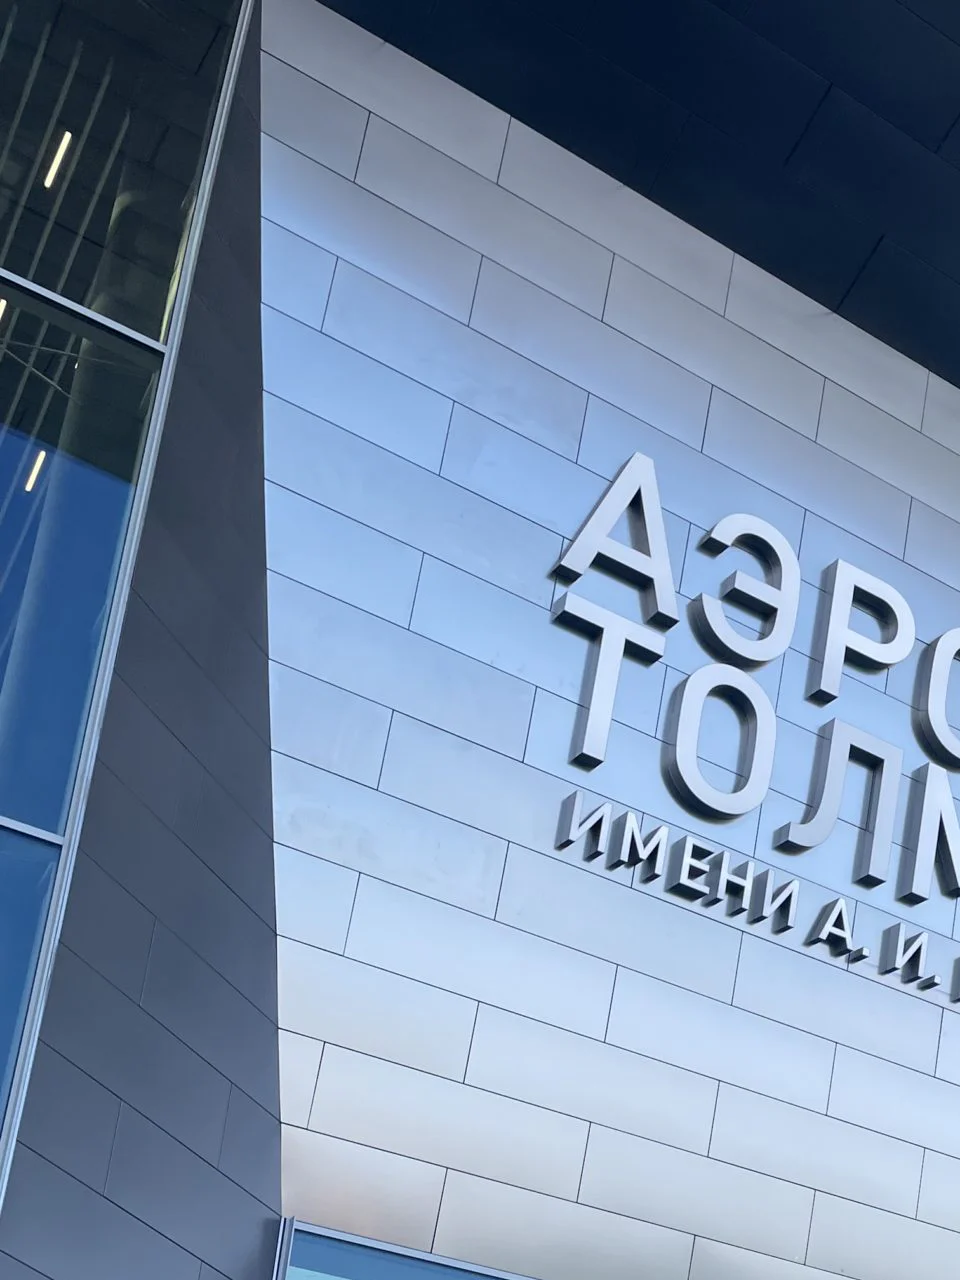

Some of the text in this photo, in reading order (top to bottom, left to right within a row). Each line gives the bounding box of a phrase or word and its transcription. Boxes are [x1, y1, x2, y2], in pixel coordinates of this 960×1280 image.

[555, 789, 801, 935] ИМЕНИ
[803, 896, 870, 963] А.
[879, 921, 942, 990] И.
